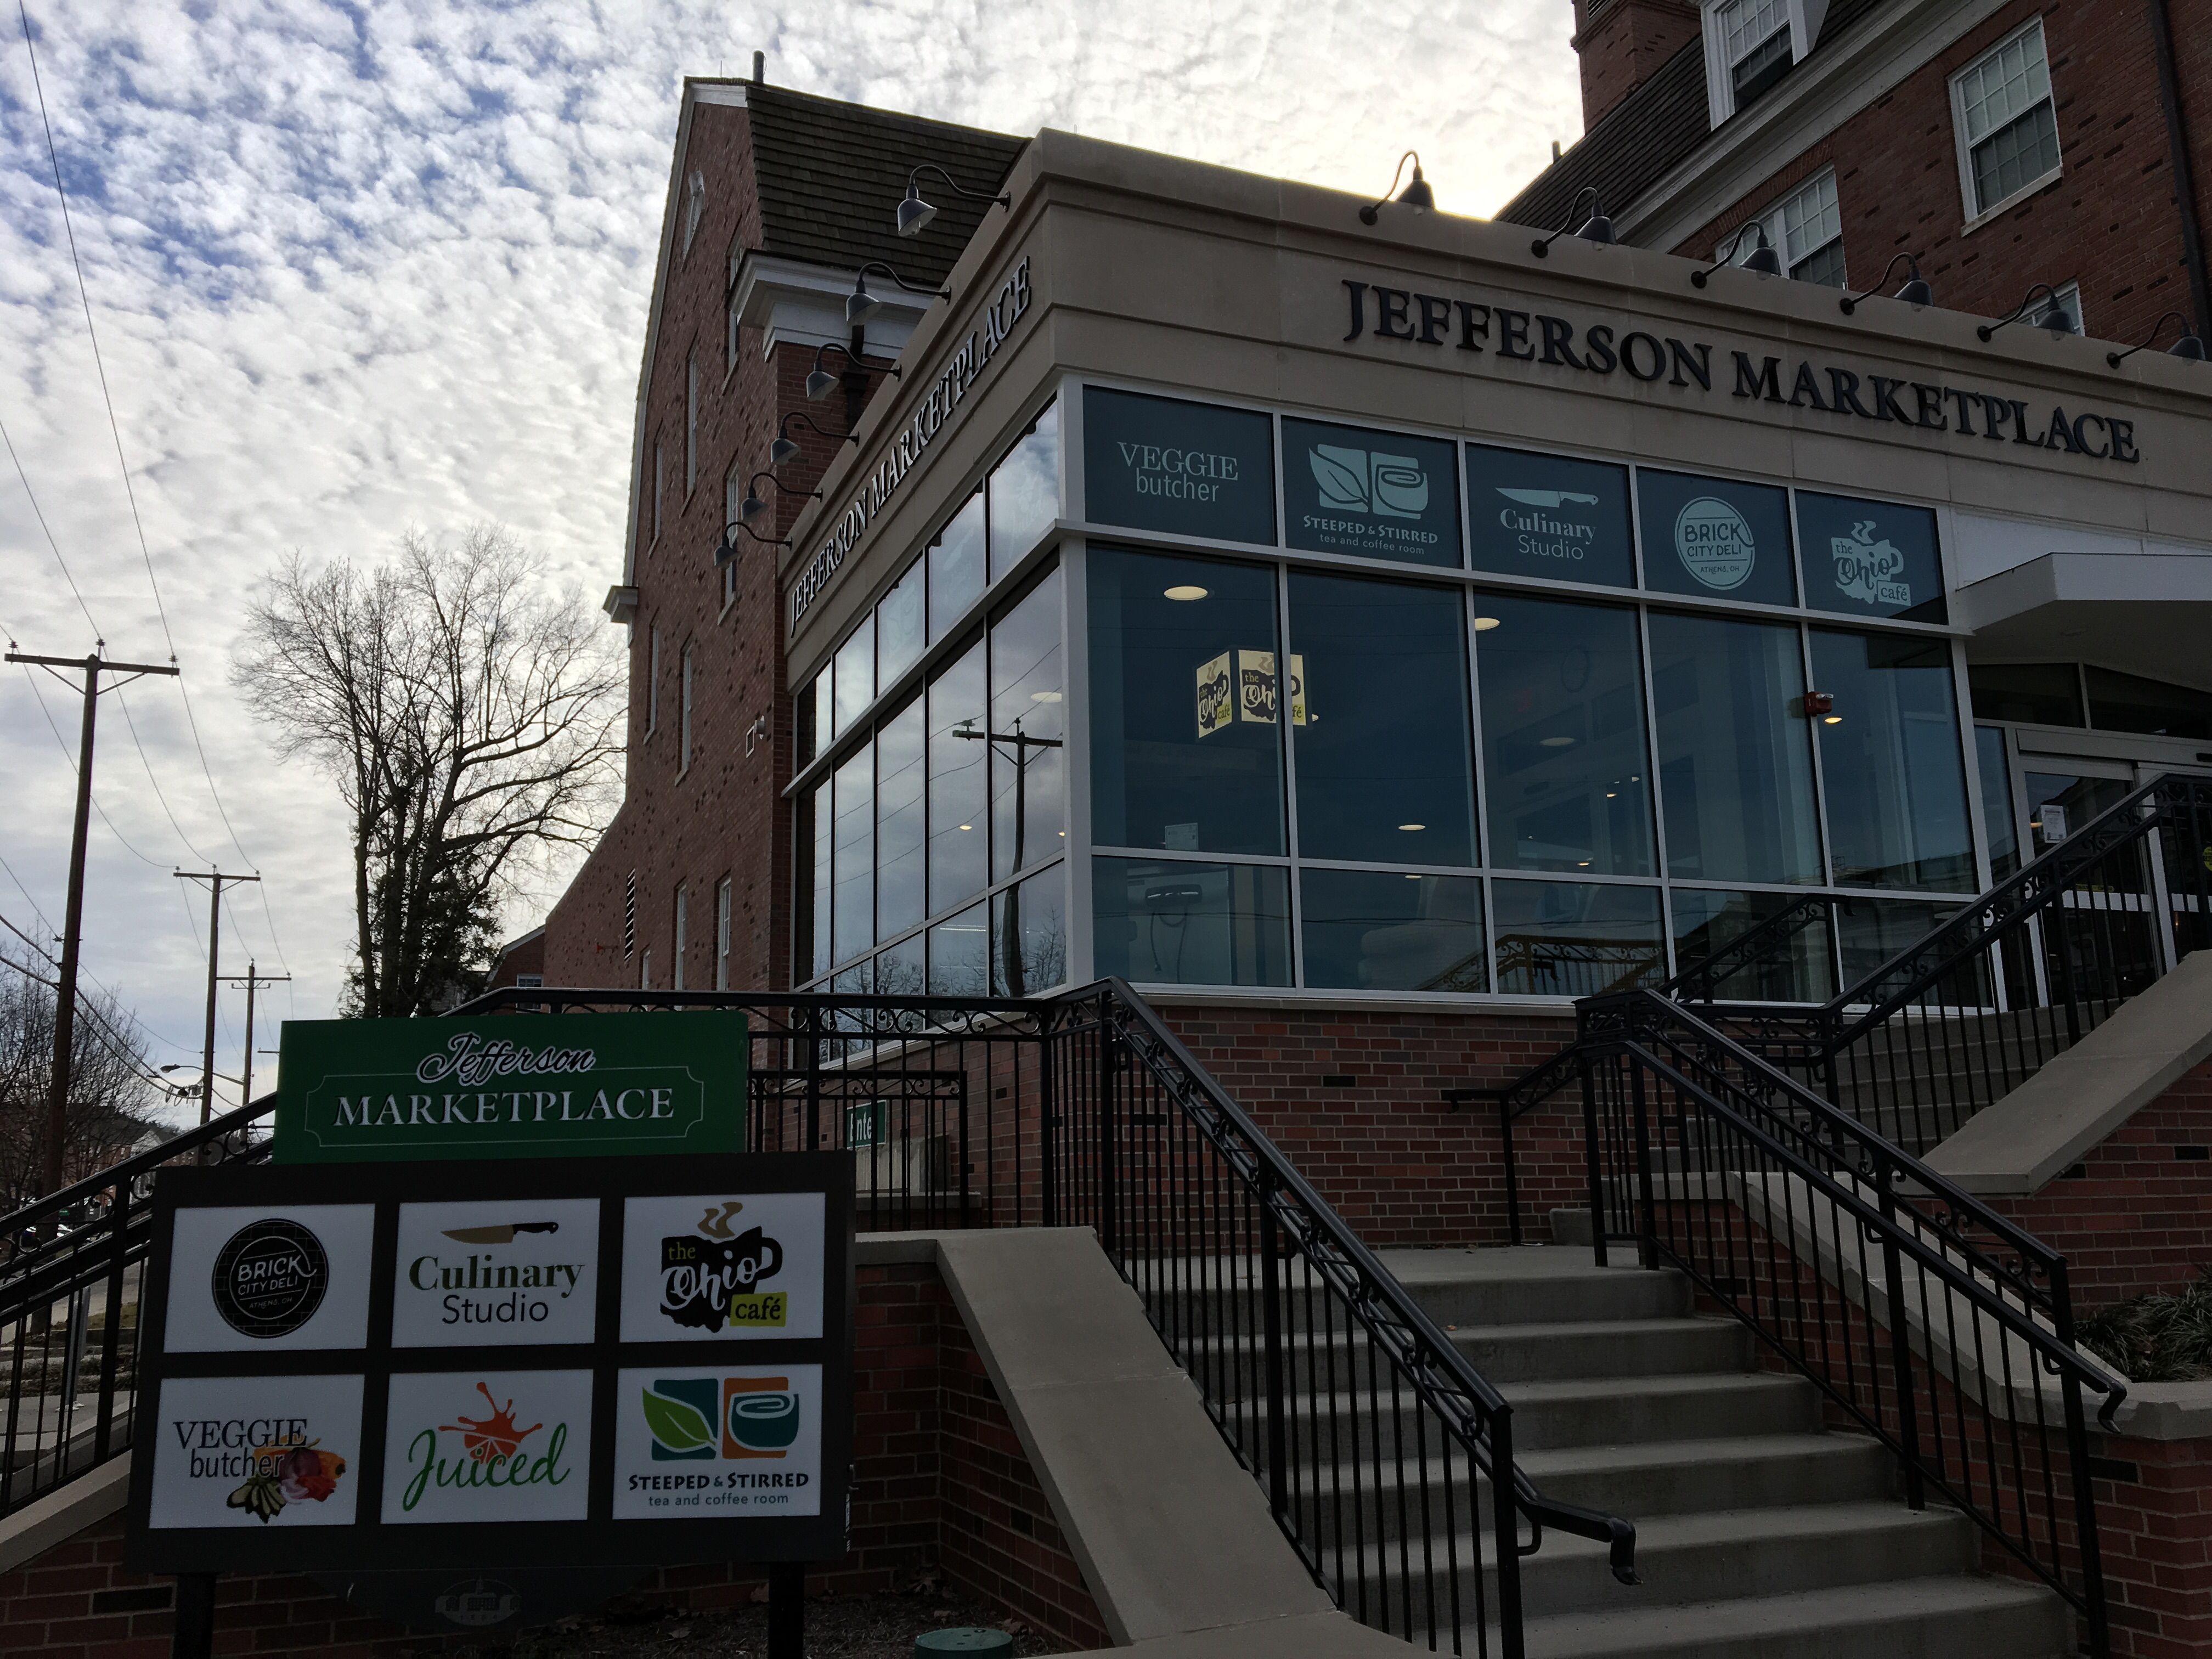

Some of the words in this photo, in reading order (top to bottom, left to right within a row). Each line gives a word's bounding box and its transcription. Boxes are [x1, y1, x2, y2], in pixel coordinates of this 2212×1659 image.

[1342, 279, 1713, 391] JEFFERSON
[1731, 350, 2140, 462] MARKETPLACE
[790, 488, 868, 638] JEFFERSON
[871, 256, 1032, 520] MARKETPLACE
[1116, 441, 1239, 481] VEGGIE
[1136, 467, 1219, 502] butcher
[1304, 515, 1365, 534] STEEPED
[1368, 526, 1375, 535] &
[1378, 524, 1438, 544] STIRRED
[1500, 509, 1597, 545] Culinary
[1685, 523, 1754, 548] BRICK
[1320, 534, 1336, 543] tea
[1340, 537, 1358, 546] and
[1363, 539, 1395, 551] coffee
[1399, 545, 1424, 555] room
[1518, 534, 1583, 560] Studio
[1687, 545, 1714, 557] CITY
[1717, 544, 1741, 556] DELI
[1836, 541, 1853, 554] the
[1834, 551, 1898, 590] Ohio
[1881, 585, 1908, 601] café
[1245, 672, 1259, 682] the
[1199, 680, 1227, 723] Ohio
[1217, 704, 1230, 720] café
[417, 1031, 596, 1086] Jefferson
[331, 1087, 675, 1126] MARKETPLACE
[668, 1242, 696, 1261] the
[238, 1255, 317, 1282] BRICK
[409, 1254, 585, 1298] Culinary
[660, 1246, 773, 1311] Ohio
[238, 1280, 268, 1295] CITY
[269, 1275, 298, 1290] DELI
[442, 1291, 549, 1324] Studio
[735, 1296, 781, 1321] café
[172, 1419, 308, 1449] VEGGIE
[190, 1447, 283, 1478] butcher
[403, 1423, 571, 1511] Juiced
[629, 1474, 710, 1491] STEEPED
[714, 1475, 723, 1487] &
[727, 1472, 809, 1488] STIRRED
[649, 1496, 669, 1506] tea
[675, 1493, 699, 1506] and
[706, 1492, 748, 1505] coffee
[754, 1494, 788, 1504] room
